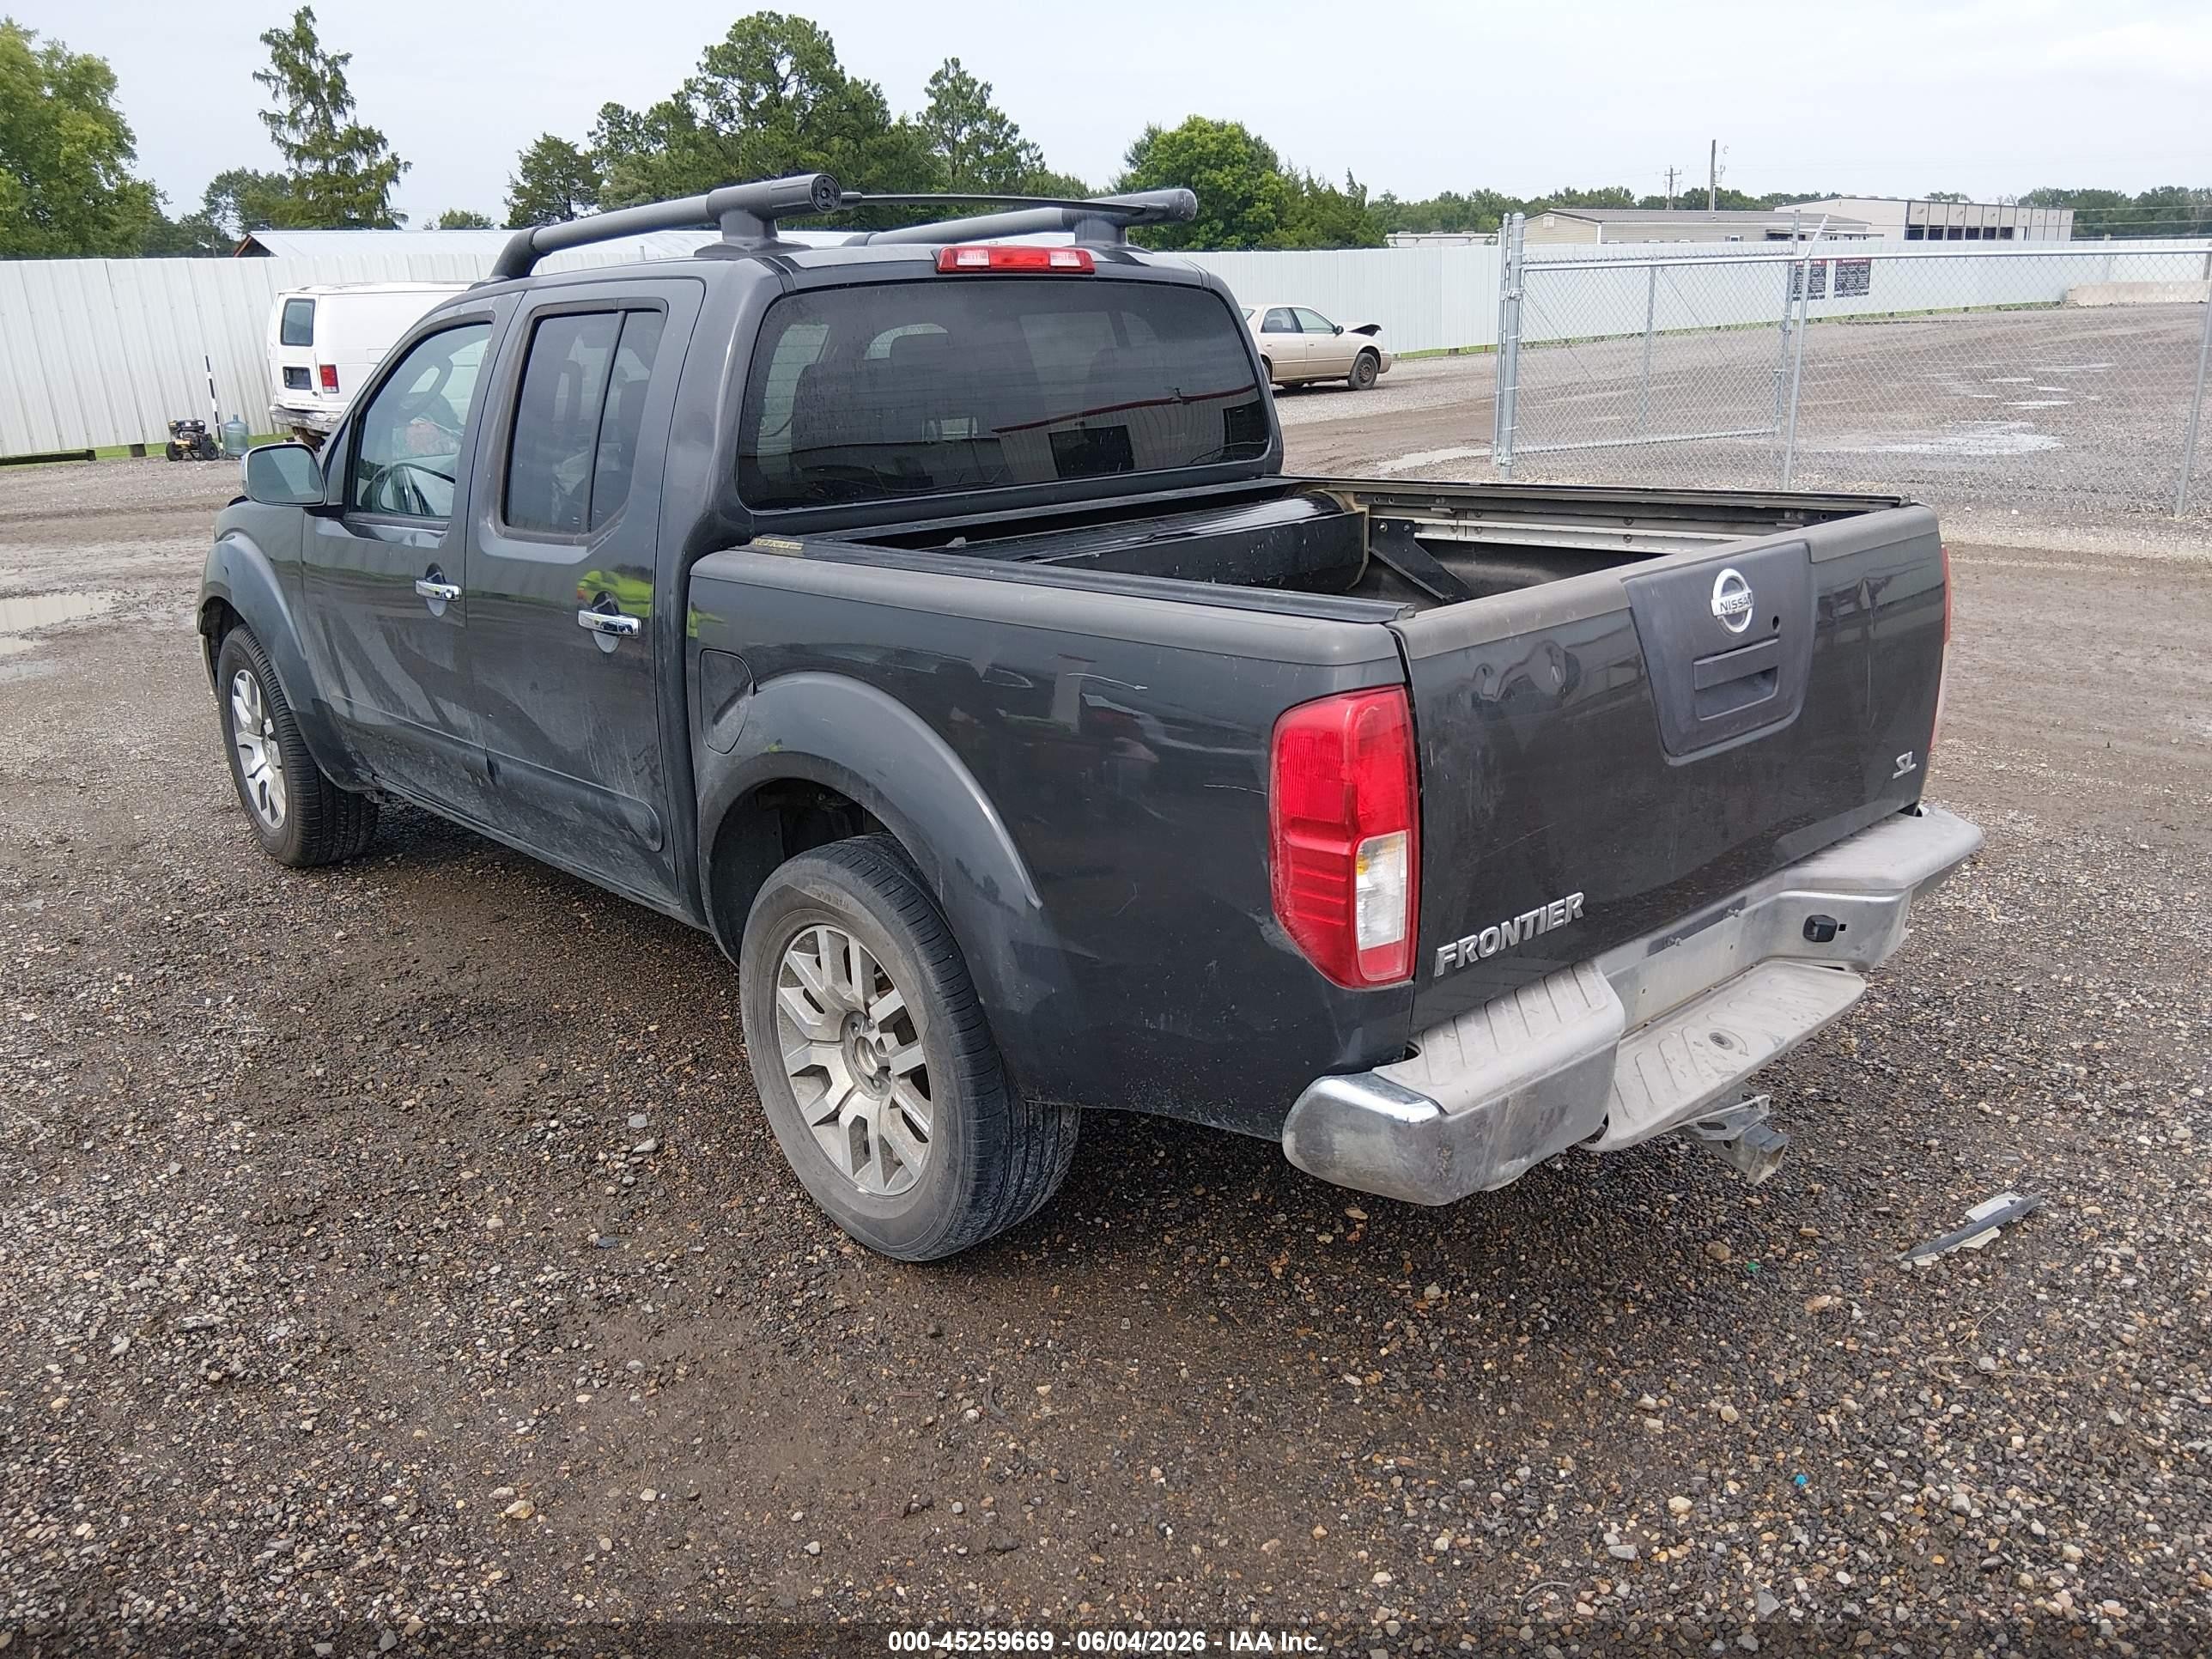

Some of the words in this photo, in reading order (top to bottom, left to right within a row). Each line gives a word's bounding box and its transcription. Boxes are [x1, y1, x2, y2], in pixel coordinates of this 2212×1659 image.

[1719, 592, 1753, 612] NISSAN
[1892, 750, 1917, 780] SL
[1434, 891, 1585, 977] FRONTIER
